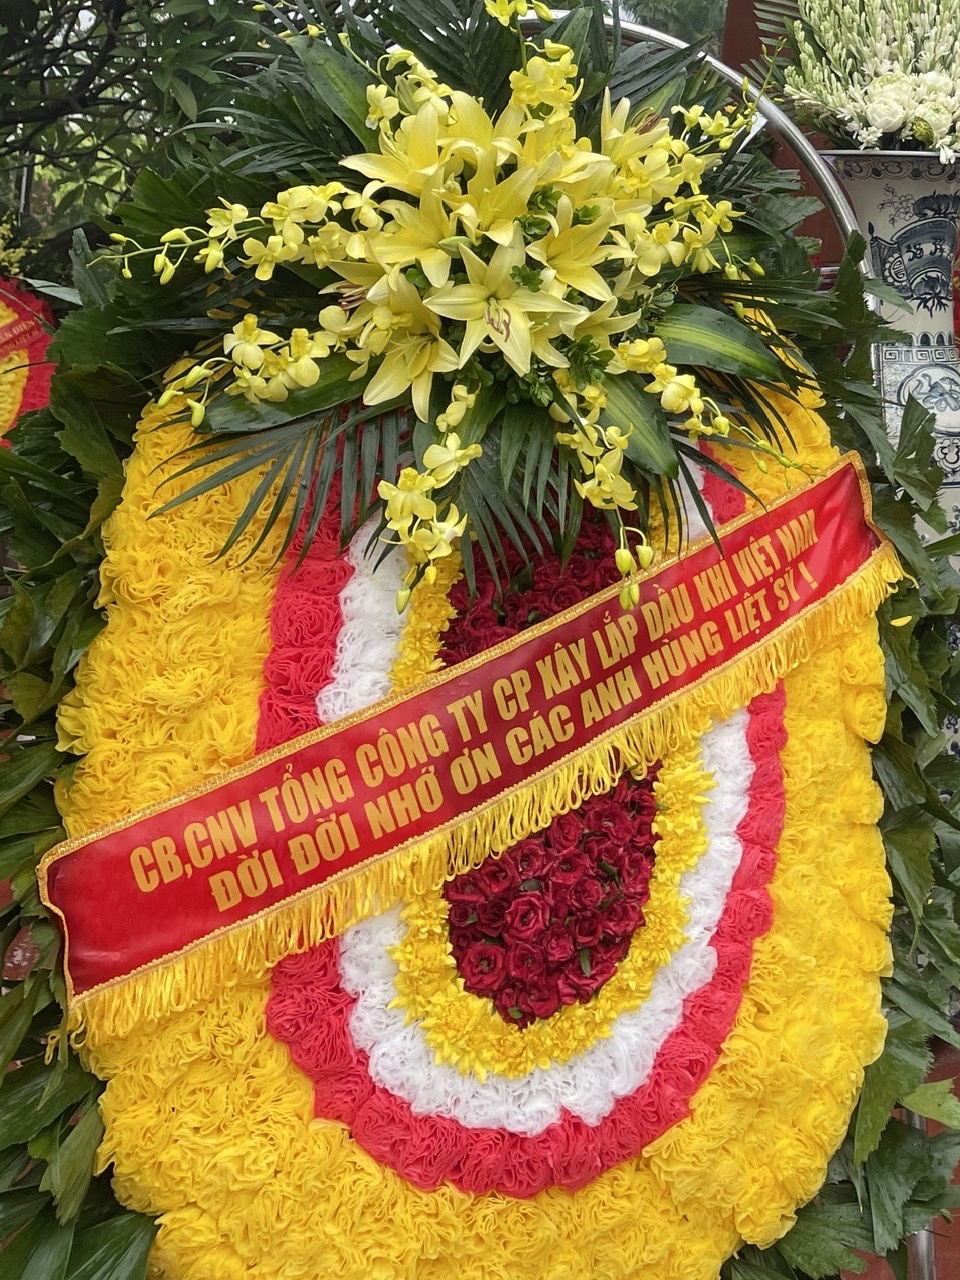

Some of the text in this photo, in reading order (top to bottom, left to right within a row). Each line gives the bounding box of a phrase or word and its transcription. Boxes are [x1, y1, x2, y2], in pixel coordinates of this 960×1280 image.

[129, 508, 819, 893] CB,CNV TỔNG CÔNG TY CP XÂY LẮP DẦU KHÍ VIỆT NAM
[208, 849, 284, 913] ĐỜI
[288, 813, 360, 876] ĐỜI
[363, 764, 444, 840] NHỚ
[450, 742, 503, 795] ƠN
[505, 704, 576, 766] CÁC
[580, 665, 643, 729] ANH
[641, 620, 725, 690] HÙNG
[723, 588, 772, 644] LIỆT
